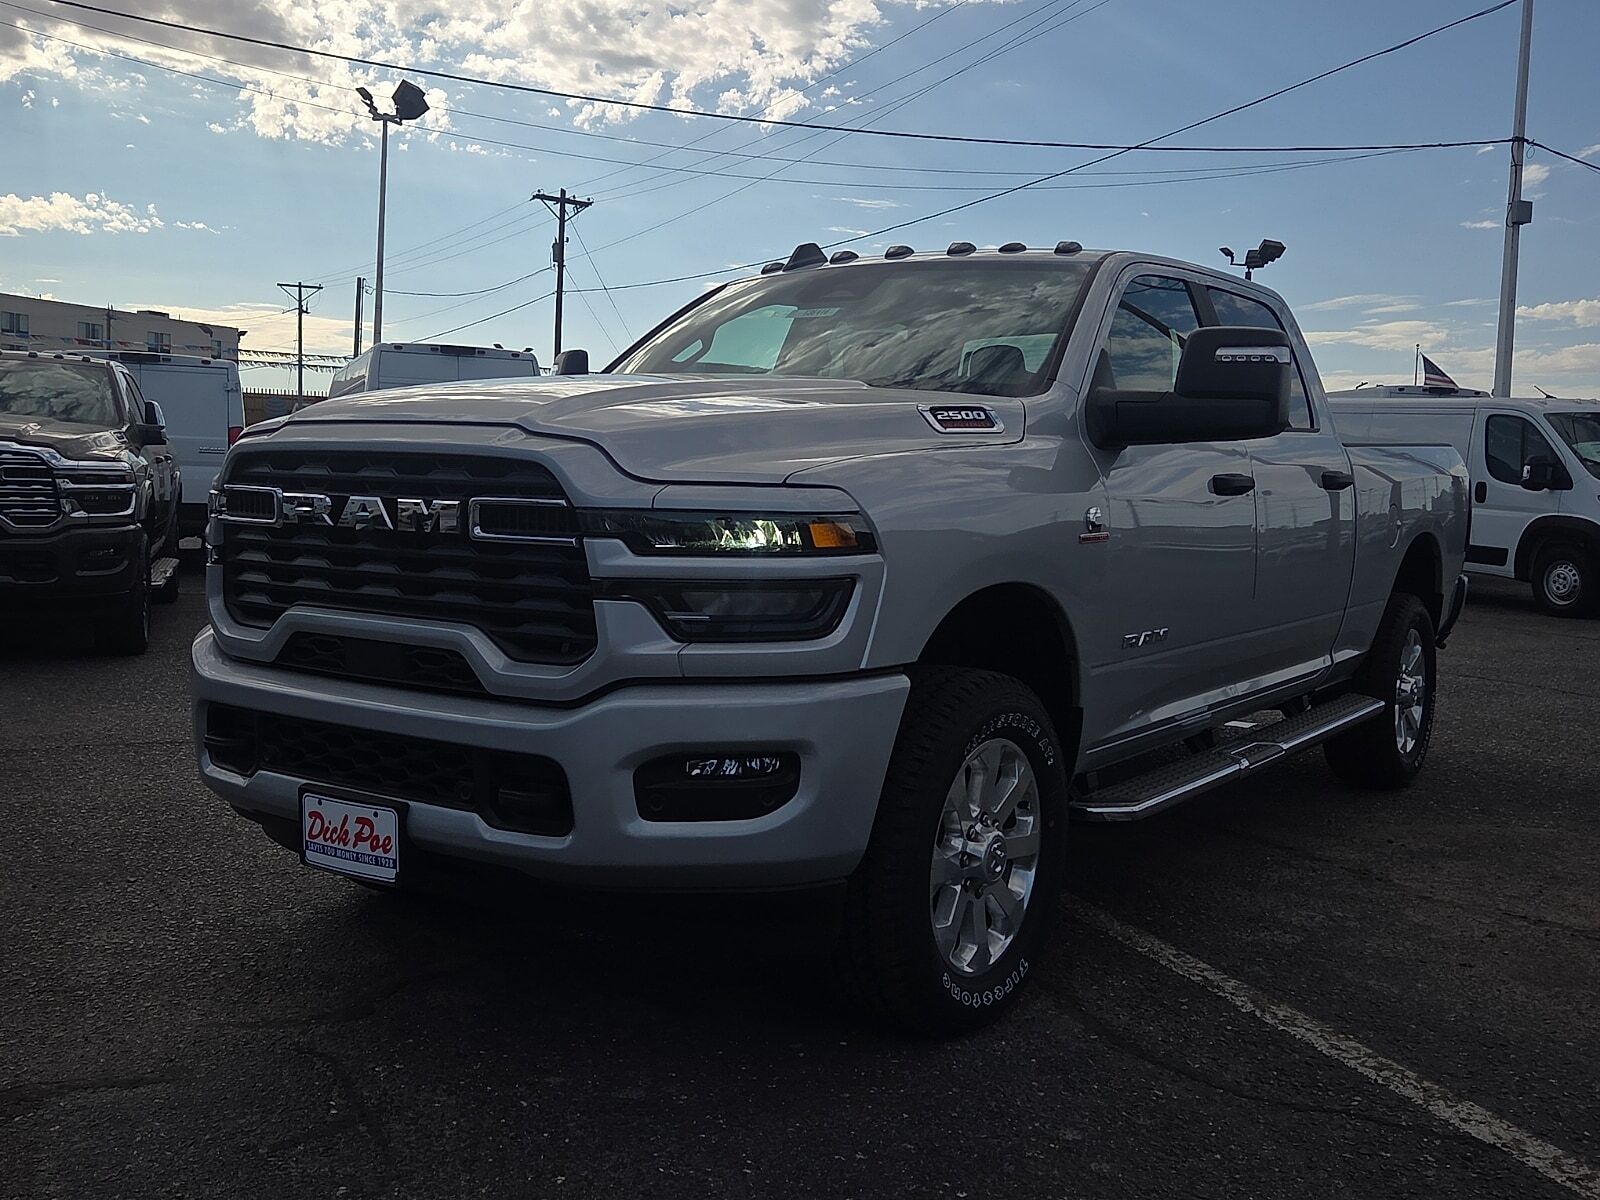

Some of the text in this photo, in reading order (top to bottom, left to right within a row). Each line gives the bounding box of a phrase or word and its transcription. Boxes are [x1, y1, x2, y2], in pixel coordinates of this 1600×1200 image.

[935, 410, 986, 420] 2500
[282, 492, 461, 534] RAM
[307, 810, 393, 855] Dick Poe
[336, 849, 357, 862] MONEY
[358, 854, 376, 866] SINCE
